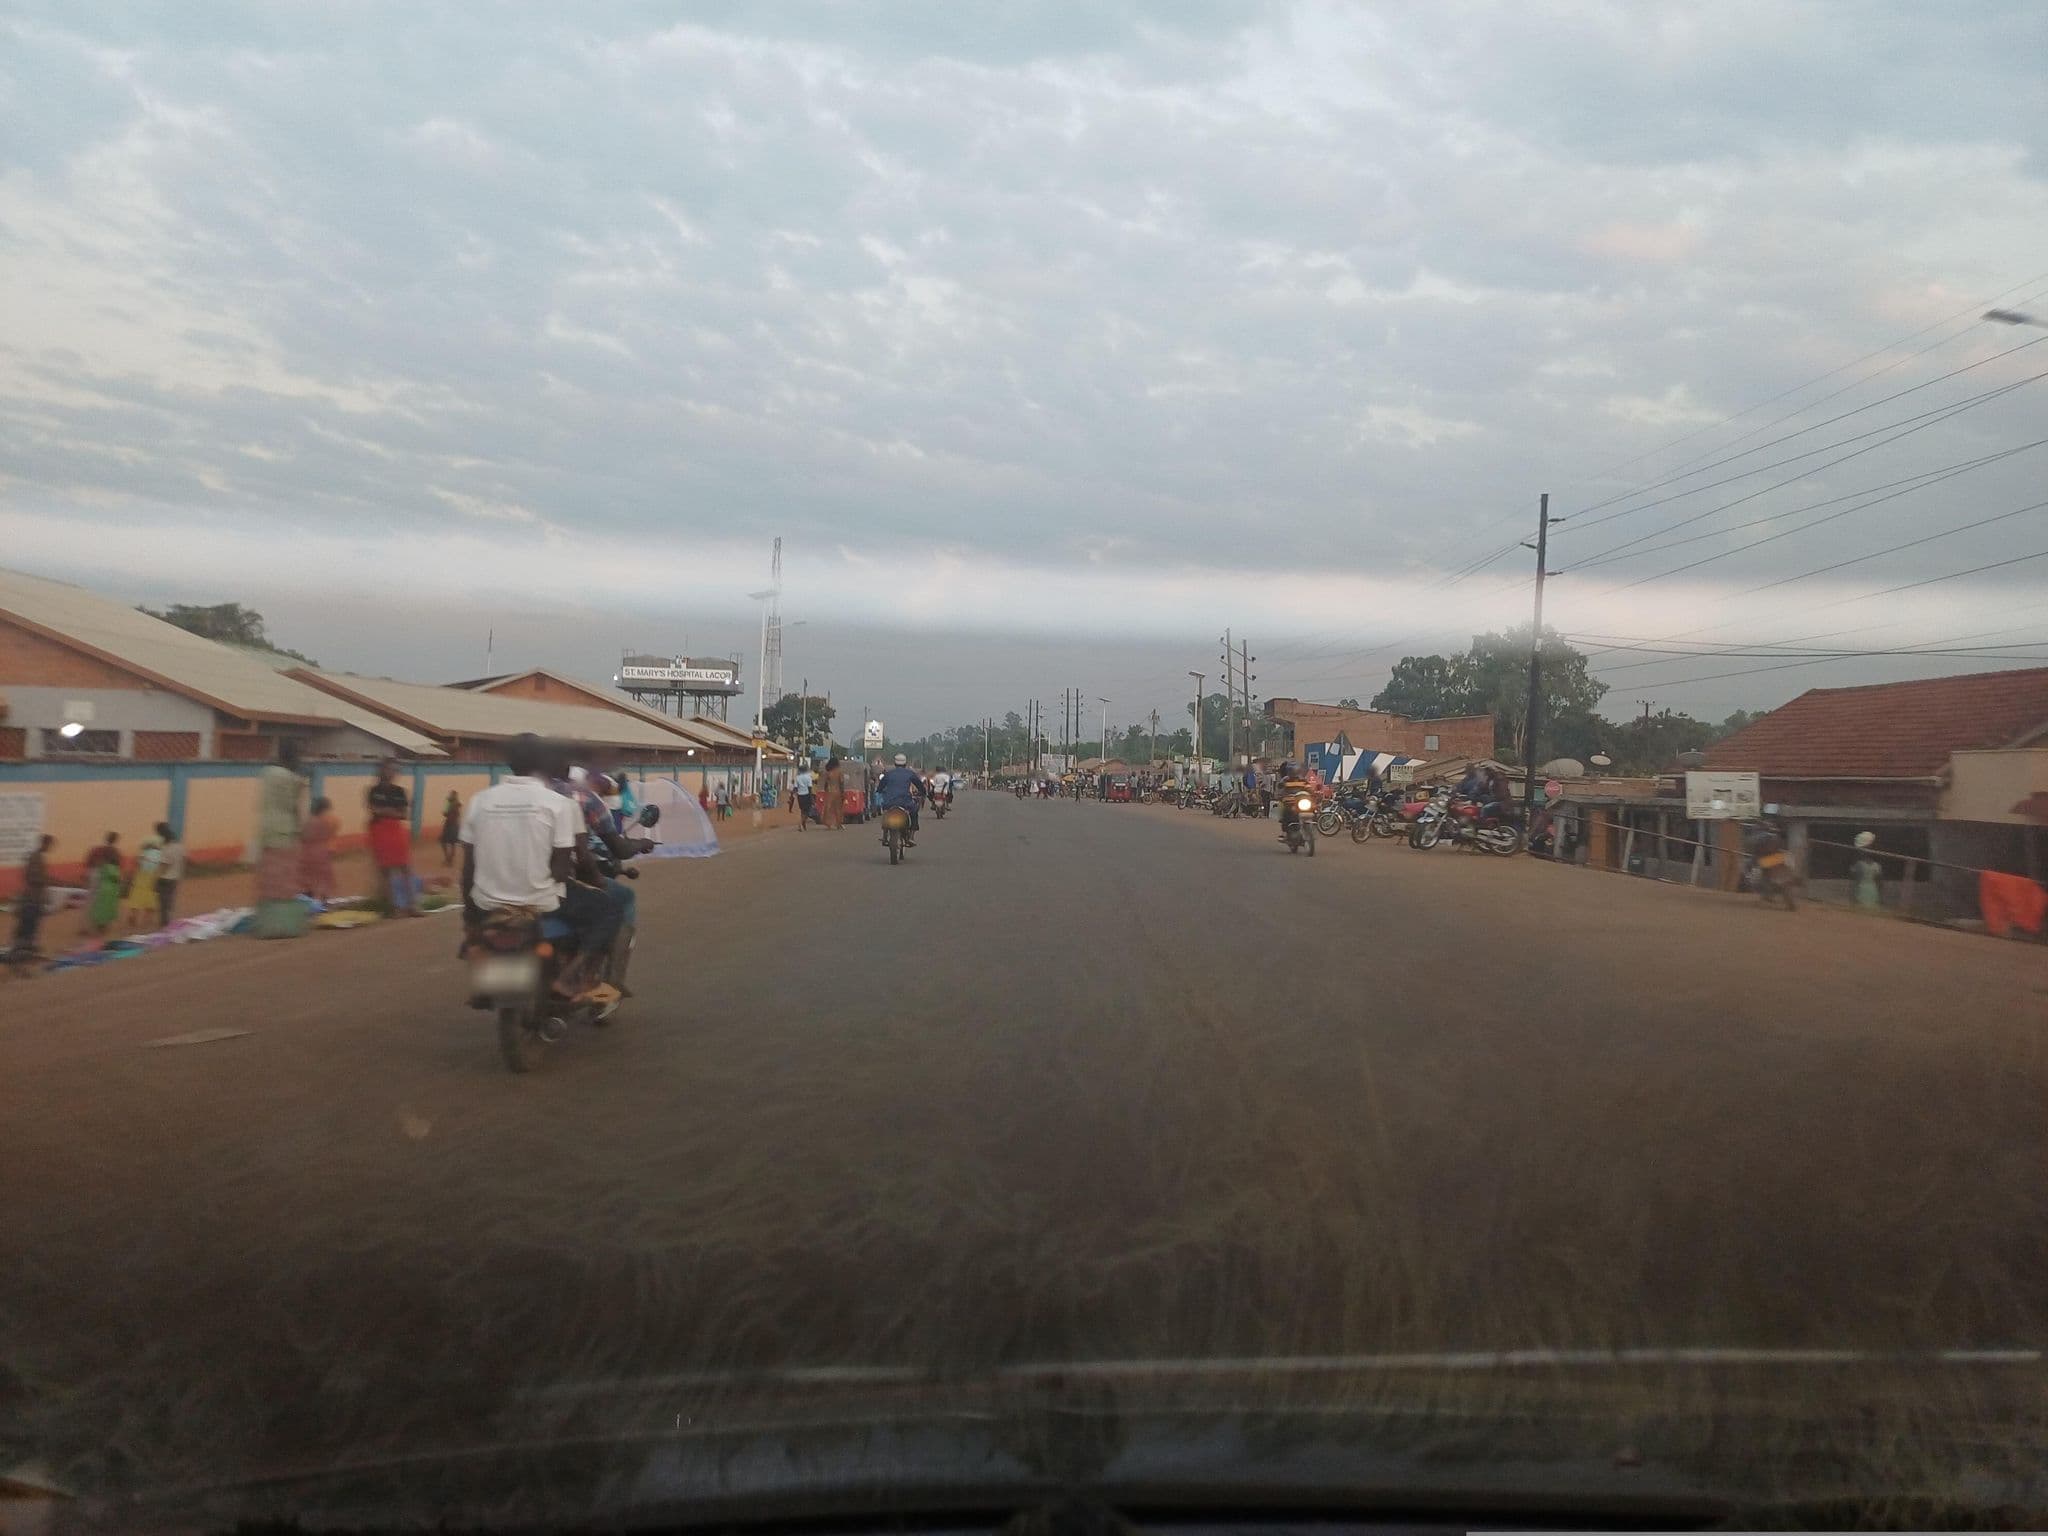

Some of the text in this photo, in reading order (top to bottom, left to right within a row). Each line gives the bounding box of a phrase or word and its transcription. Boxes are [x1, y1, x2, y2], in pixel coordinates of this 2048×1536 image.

[624, 668, 732, 680] ST. MARY'S HOSPITAL LACOR
